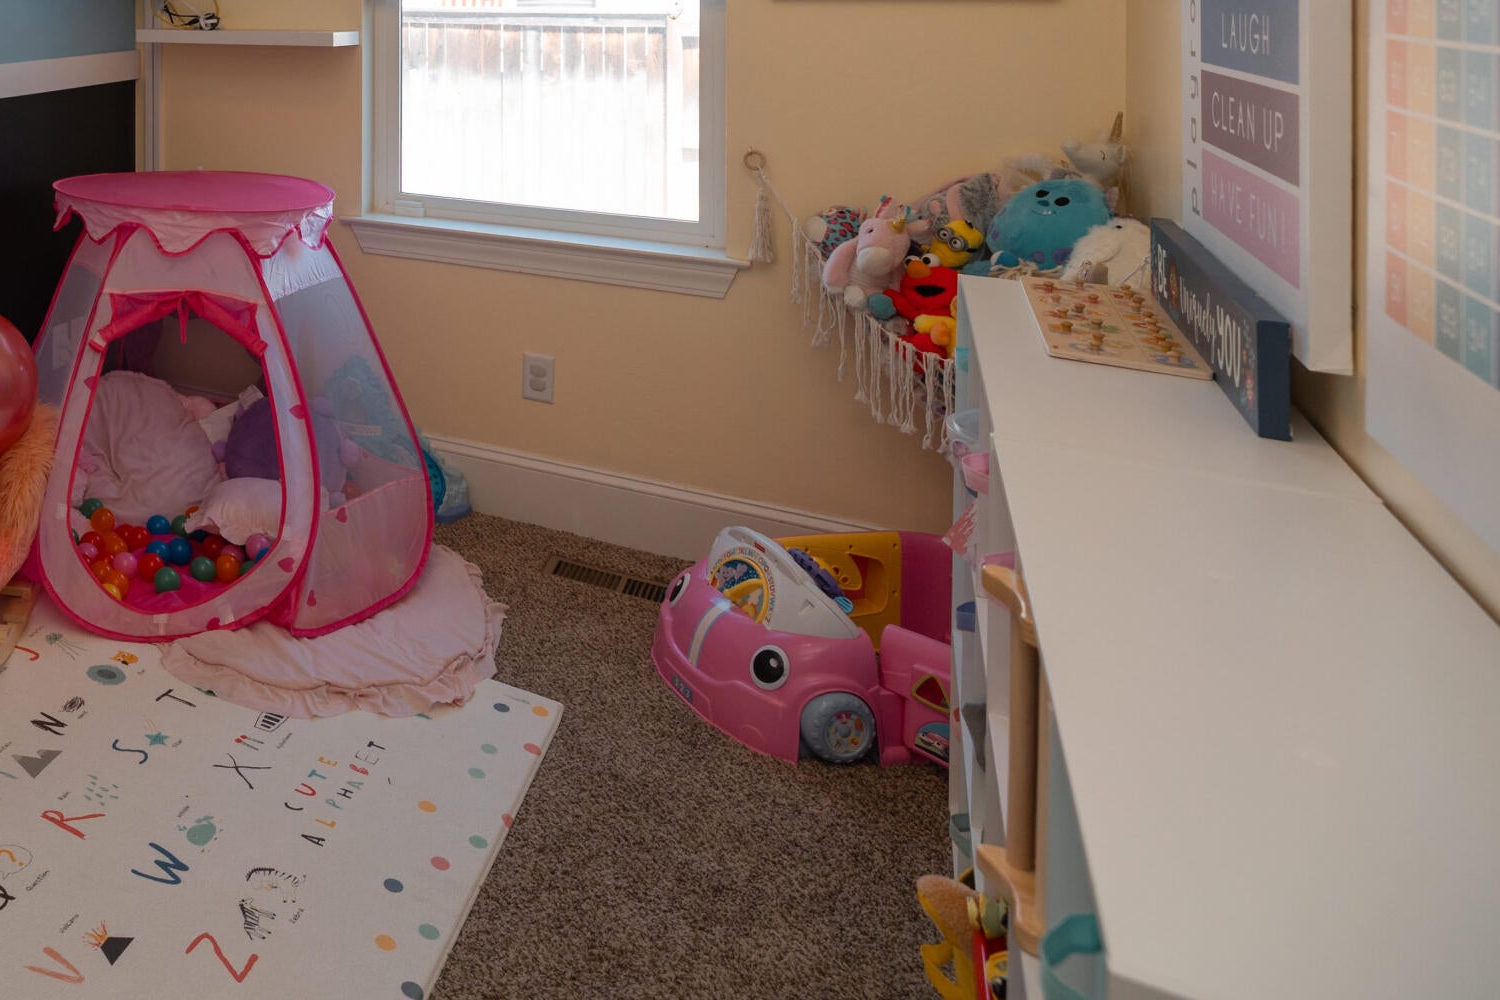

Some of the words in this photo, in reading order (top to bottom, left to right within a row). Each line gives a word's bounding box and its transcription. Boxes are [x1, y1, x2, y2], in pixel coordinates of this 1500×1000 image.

[1221, 12, 1271, 57] LAUGH
[1211, 91, 1256, 140] CLEAN
[1262, 103, 1285, 154] UP
[1211, 173, 1243, 226] HAVE
[1248, 192, 1288, 254] FUN!
[1216, 303, 1241, 388] YOU
[284, 755, 338, 811] CUTE
[301, 740, 386, 848] ALPHABET
